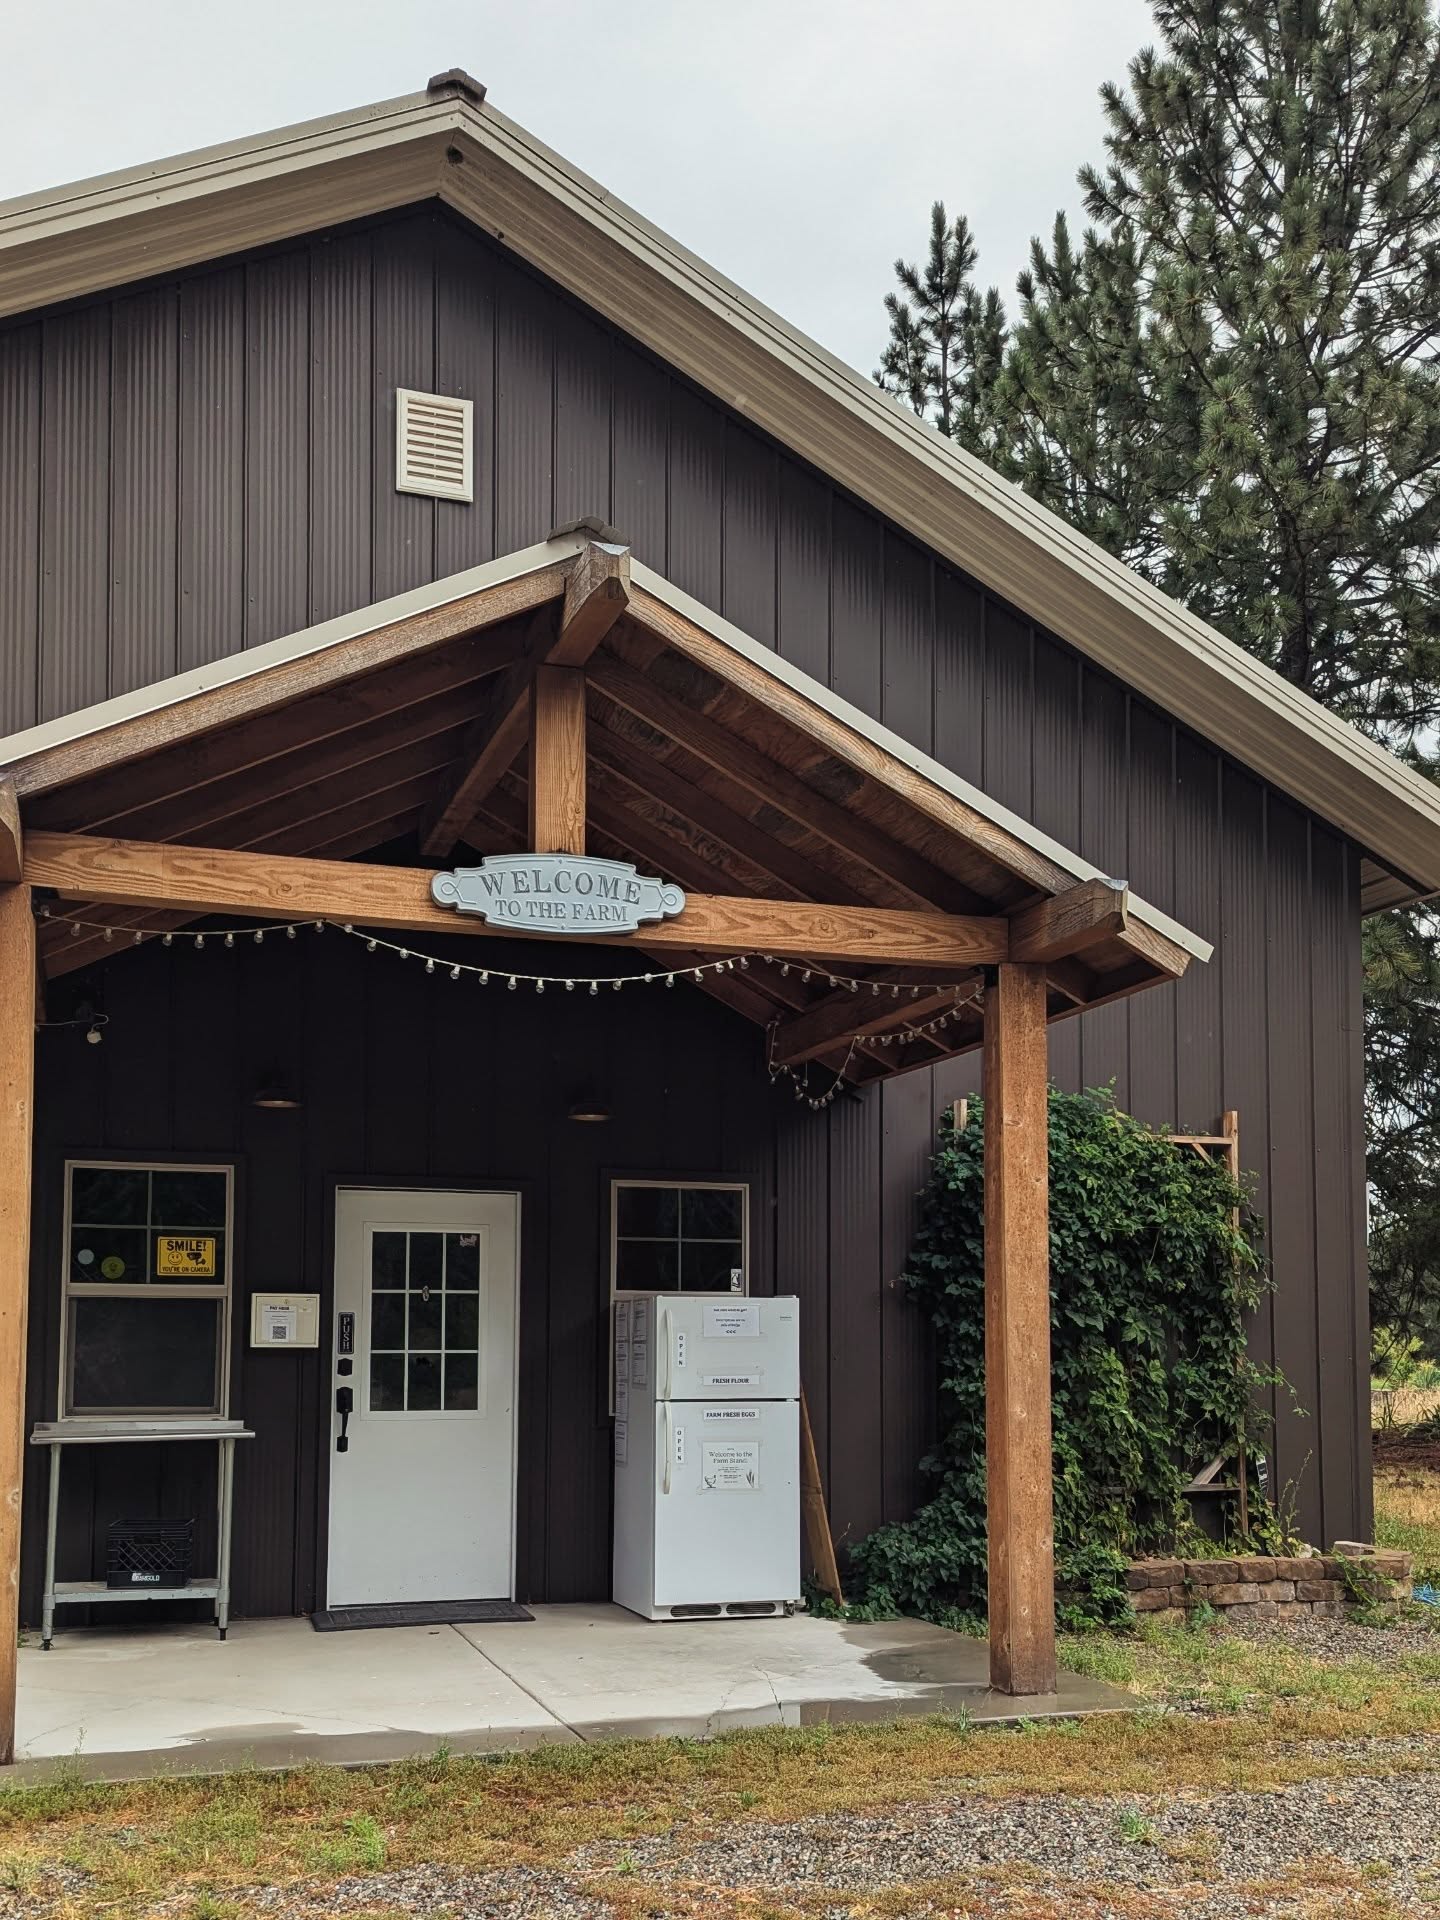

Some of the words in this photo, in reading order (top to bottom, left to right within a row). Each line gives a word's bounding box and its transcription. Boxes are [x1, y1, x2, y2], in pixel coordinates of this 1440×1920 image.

[479, 869, 642, 905] WELCOME
[495, 899, 521, 917] TO
[526, 901, 566, 919] THE
[571, 904, 628, 922] FARM
[166, 1240, 207, 1252] SMILE!
